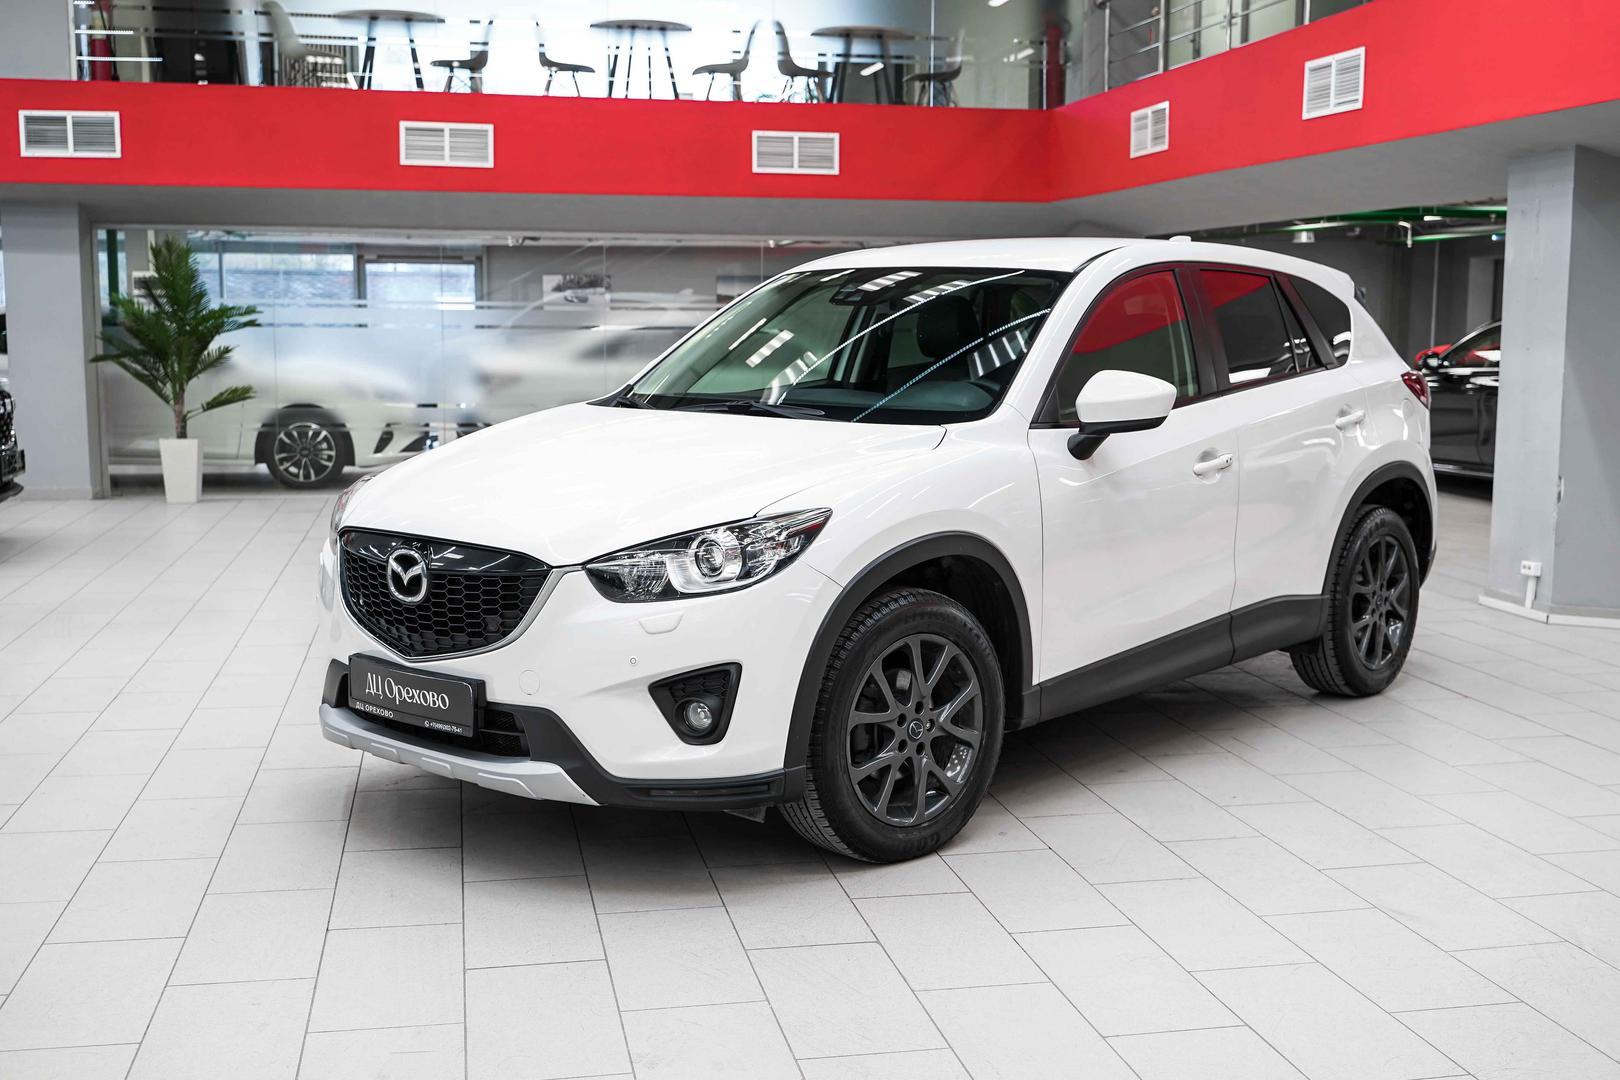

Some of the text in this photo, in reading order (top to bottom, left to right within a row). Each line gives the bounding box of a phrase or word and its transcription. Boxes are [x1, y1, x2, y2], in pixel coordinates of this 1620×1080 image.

[366, 672, 449, 710] ДЦ Орехово
[354, 701, 394, 718] ДЦ ОРЕХОВО
